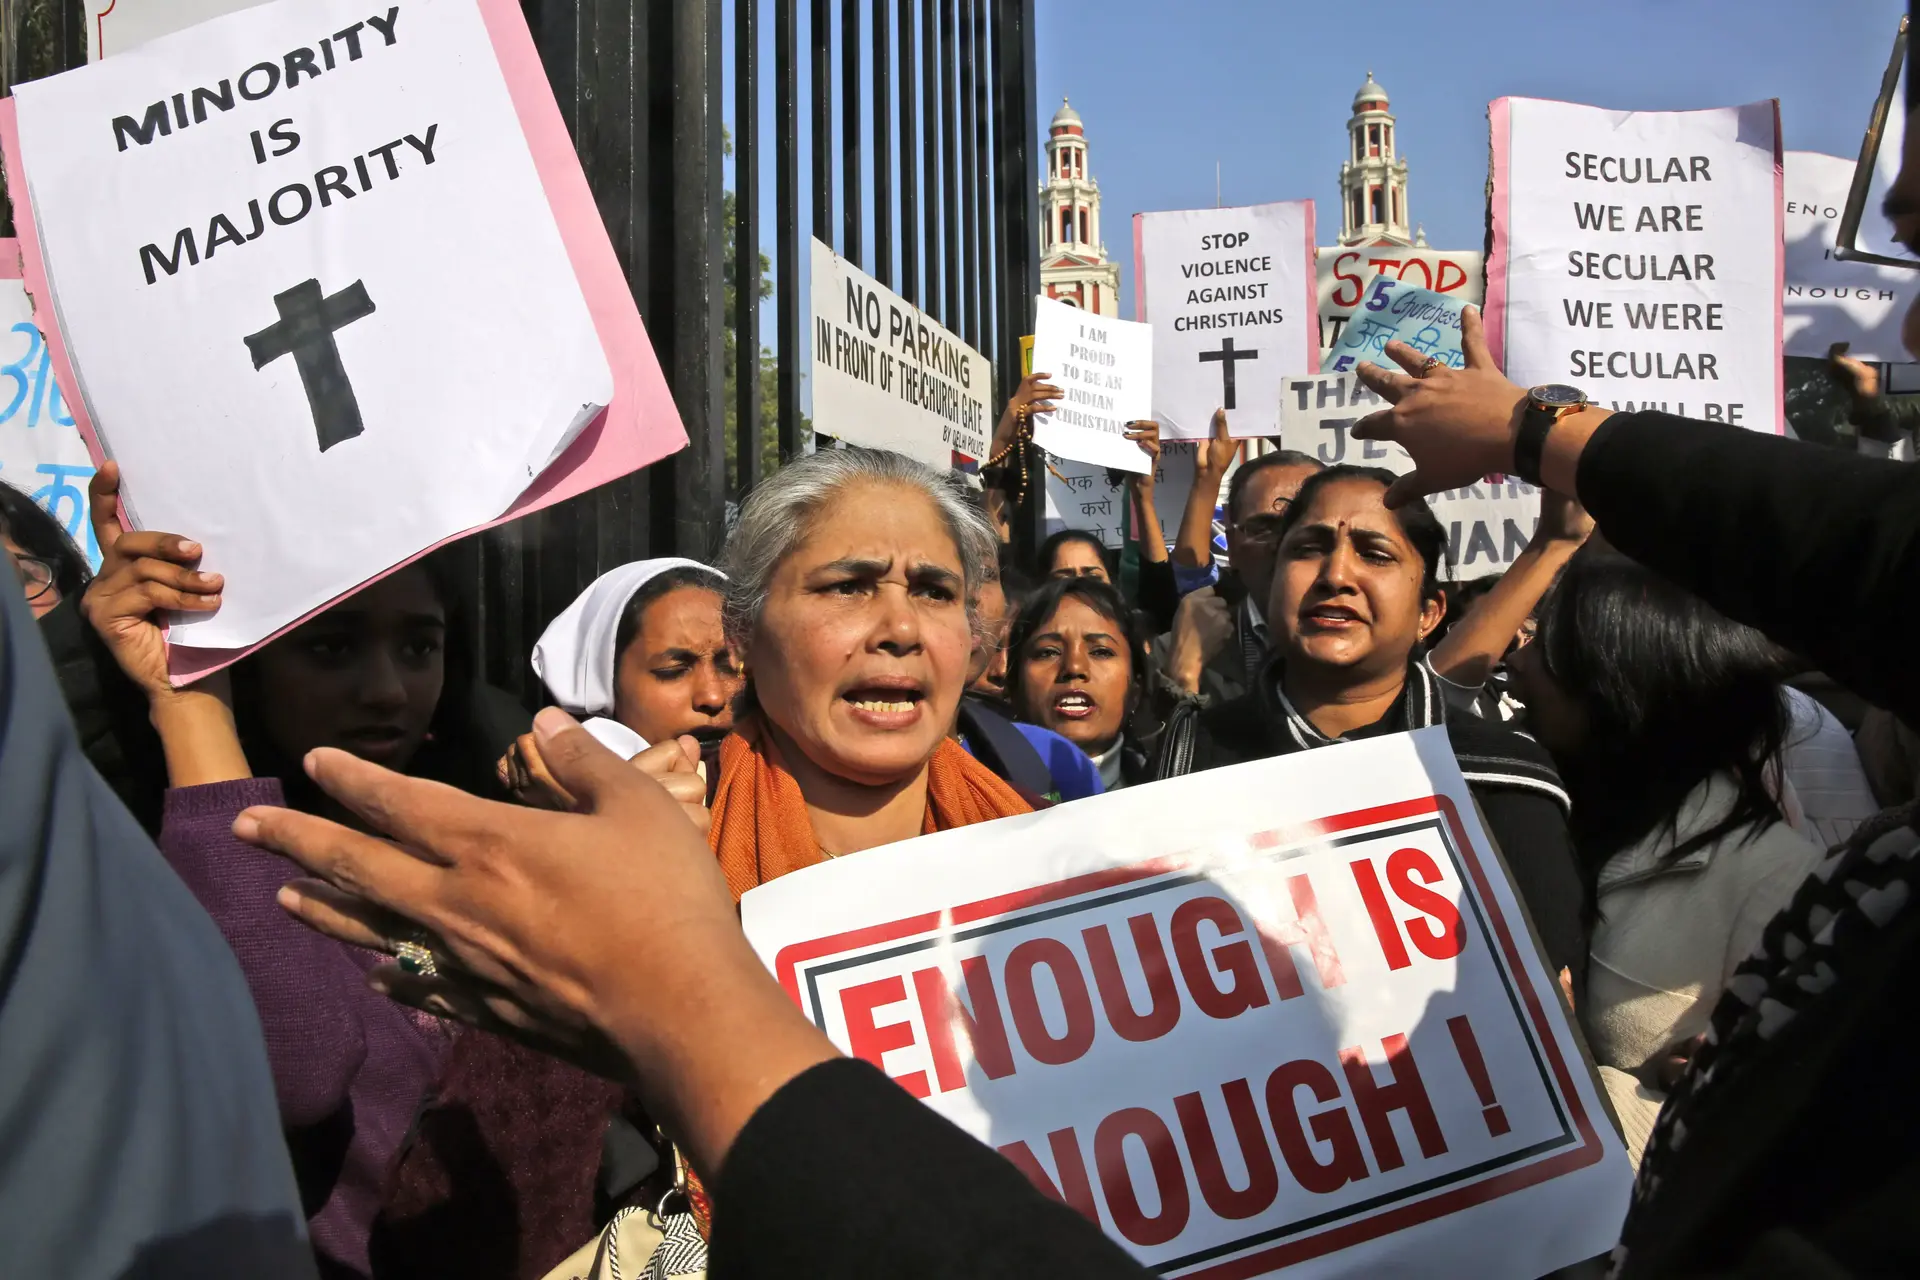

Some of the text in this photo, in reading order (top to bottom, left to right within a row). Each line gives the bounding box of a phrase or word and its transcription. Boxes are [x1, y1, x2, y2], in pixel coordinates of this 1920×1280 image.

[111, 6, 401, 152] MINORITY
[250, 118, 301, 164] IS
[1565, 151, 1713, 183] SECULAR
[139, 123, 439, 285] MAJORITY
[1573, 201, 1704, 232] WE ARE
[1786, 201, 1838, 219] ENO
[1201, 231, 1250, 251] STOP
[1181, 256, 1271, 279] VIOLENCE
[1567, 250, 1716, 281] SECULAR
[1186, 283, 1269, 305] AGAINST
[1365, 281, 1396, 312] 5
[1787, 285, 1894, 301] NOUGH
[1174, 308, 1284, 332] CHRISTIANS
[1562, 298, 1724, 331] WE WERE
[846, 276, 970, 389] NO PARKING
[1079, 324, 1107, 344] I AM
[1070, 343, 1116, 367] PROUD
[1569, 349, 1719, 381] SECULAR
[816, 315, 831, 367] IN
[836, 326, 876, 386] FRONT
[880, 350, 894, 393] OF
[921, 371, 959, 424] CHURCH
[962, 393, 983, 435] GATE
[1062, 362, 1122, 390] TO BE AN
[1068, 387, 1114, 411] INDIAN
[1290, 377, 1388, 411] THA
[1055, 406, 1125, 435] CHRISTIAN
[942, 424, 984, 458] BY DELHI POLICE
[1064, 474, 1094, 495] एक
[1079, 495, 1113, 517] करो
[838, 846, 1469, 1100] ENOUGH IS
[996, 1032, 1450, 1248] NOUGH
